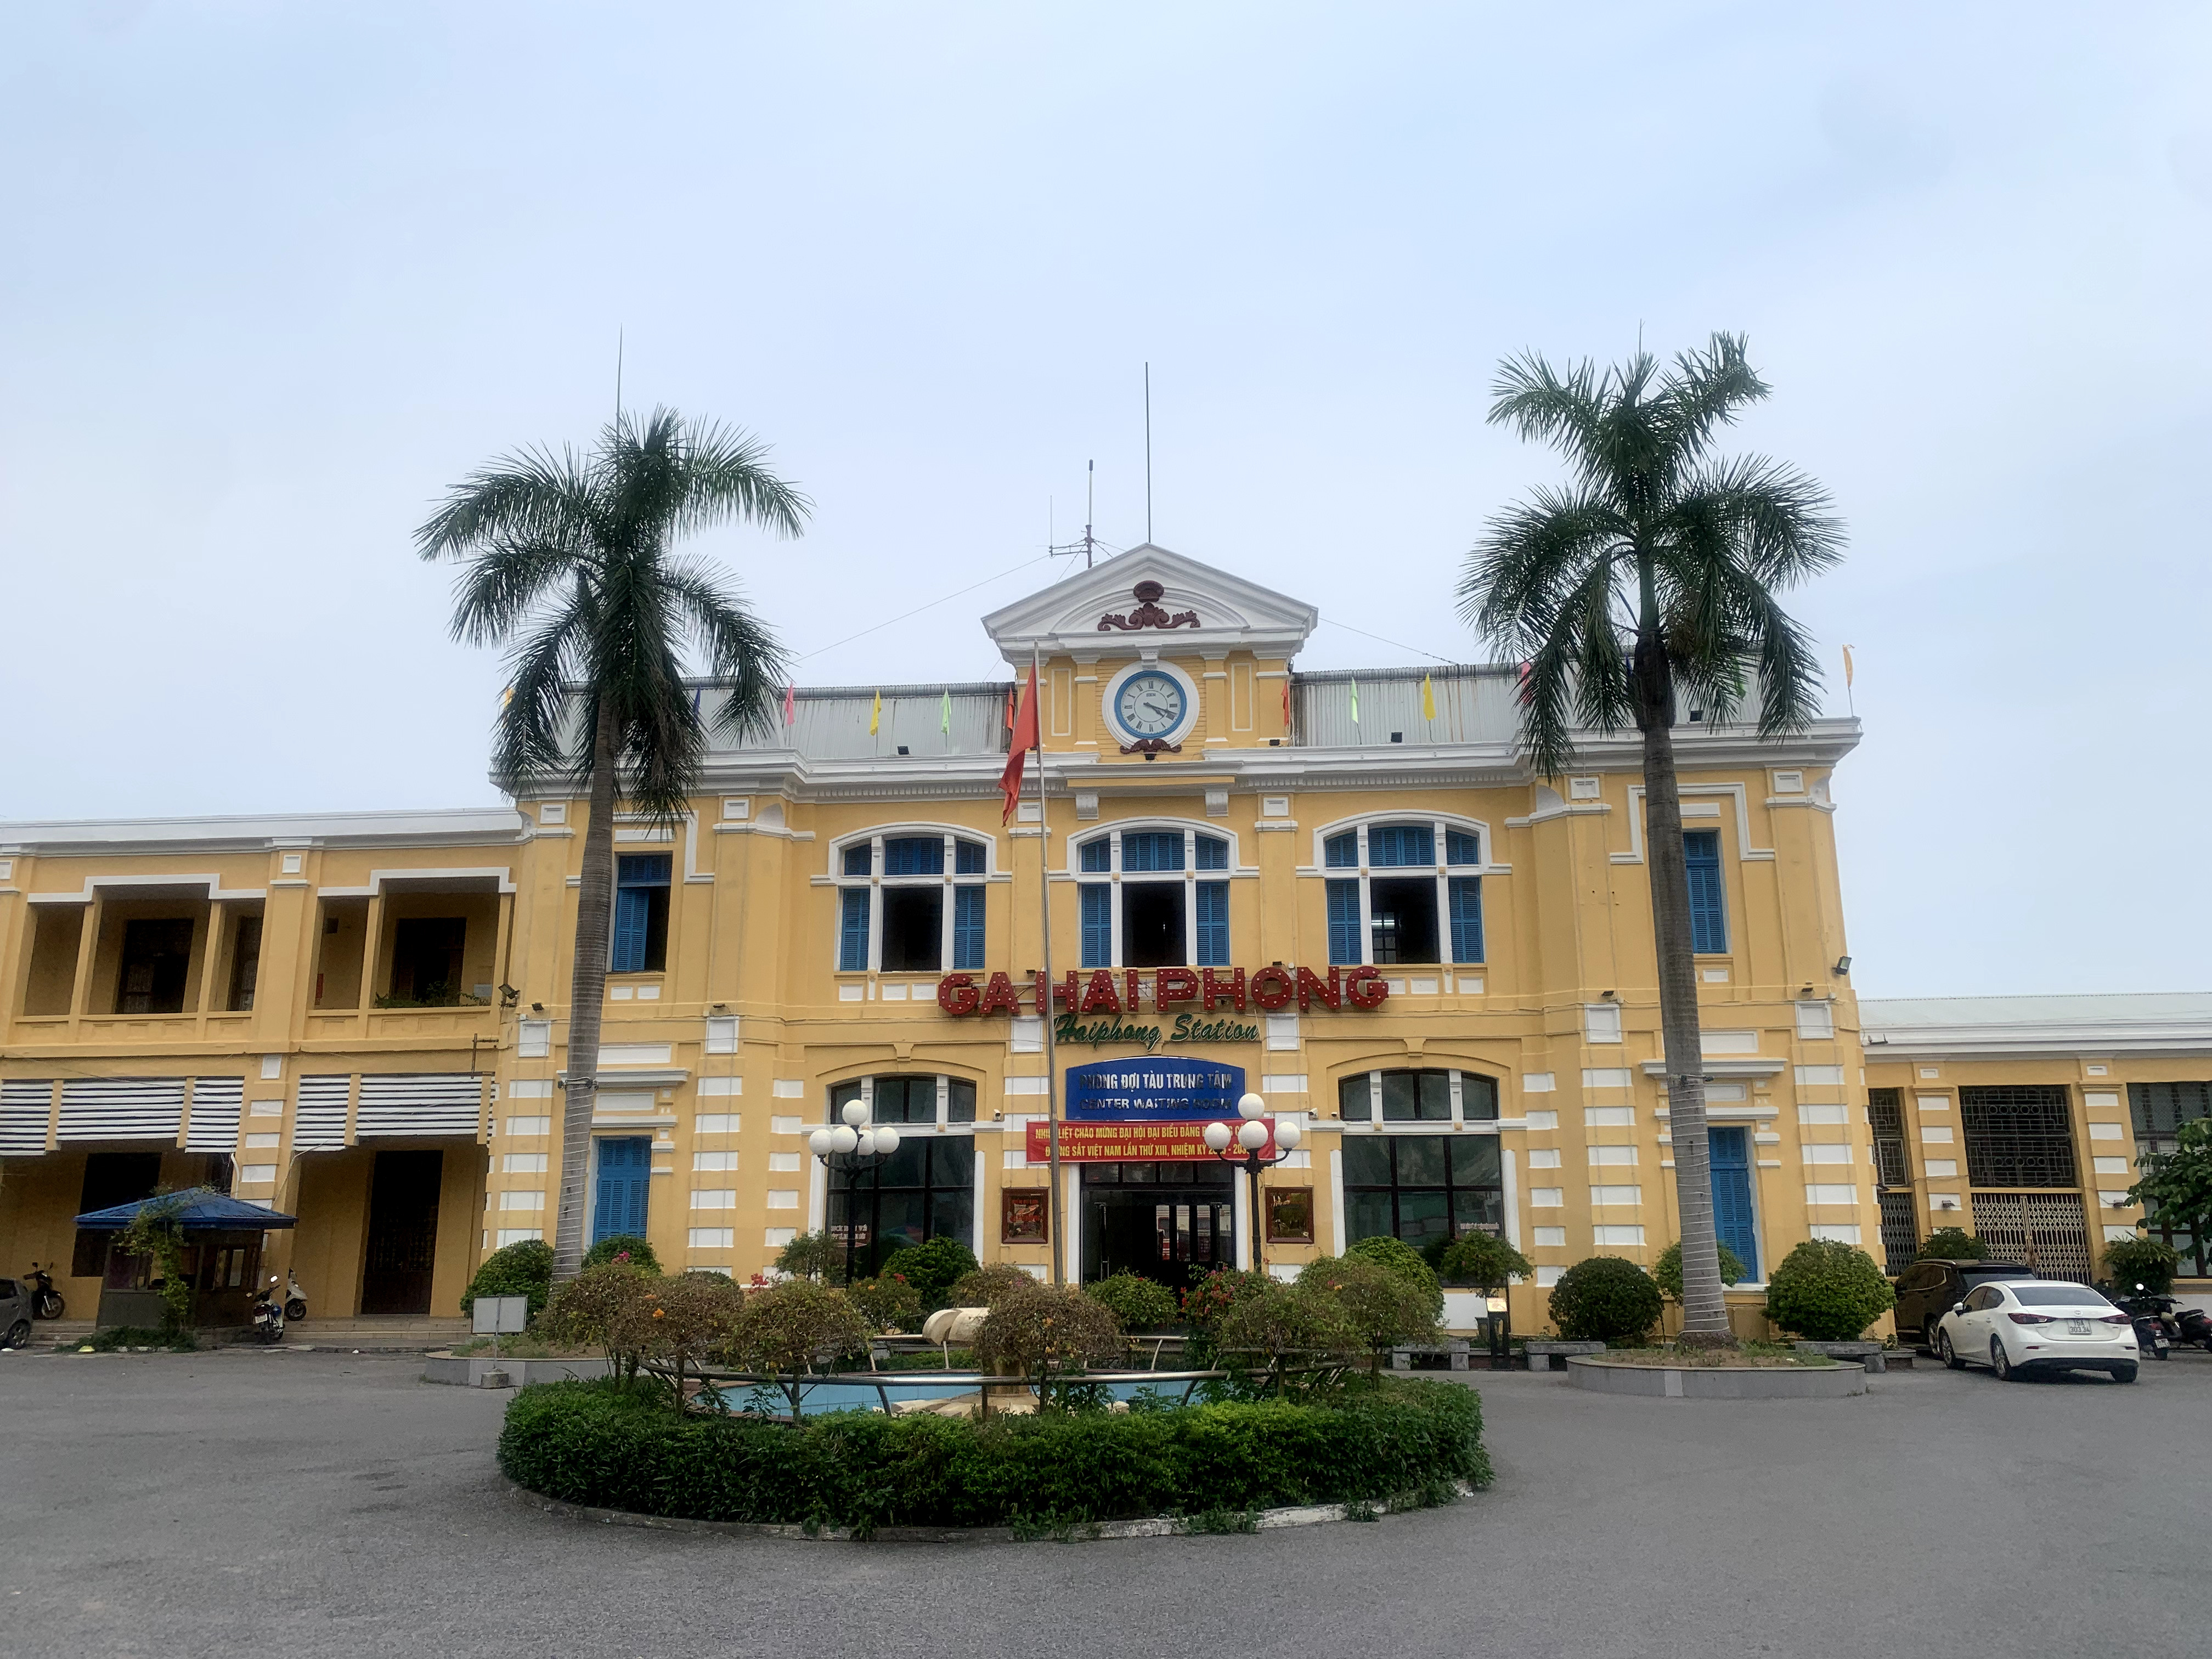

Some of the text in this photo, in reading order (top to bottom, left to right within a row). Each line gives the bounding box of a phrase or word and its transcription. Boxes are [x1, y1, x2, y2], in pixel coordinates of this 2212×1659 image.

[938, 966, 1389, 1014] GA HAI PHONG
[1053, 1013, 1260, 1051] Haiphong Station
[1079, 1070, 1232, 1092] PHÒNG ĐỢI TÀU TRUNG TÂM
[1080, 1098, 1232, 1109] CENTER WAITING ROOM
[1075, 1126, 1094, 1139] CHÀO
[1096, 1126, 1118, 1138] MỪNG
[1119, 1127, 1132, 1141] ĐẠI
[1133, 1125, 1146, 1141] HỘI
[1148, 1127, 1160, 1140] ĐẠI
[1161, 1123, 1178, 1138] BIỂU
[1180, 1124, 1200, 1137] ĐẢNG
[1072, 1142, 1086, 1156] SẮT
[1087, 1143, 1103, 1159] VIỆT
[1104, 1145, 1121, 1156] NAM
[1139, 1143, 1154, 1156] THỨ
[1155, 1144, 1170, 1156] XIII,
[1171, 1142, 1195, 1158] NHIỆM
